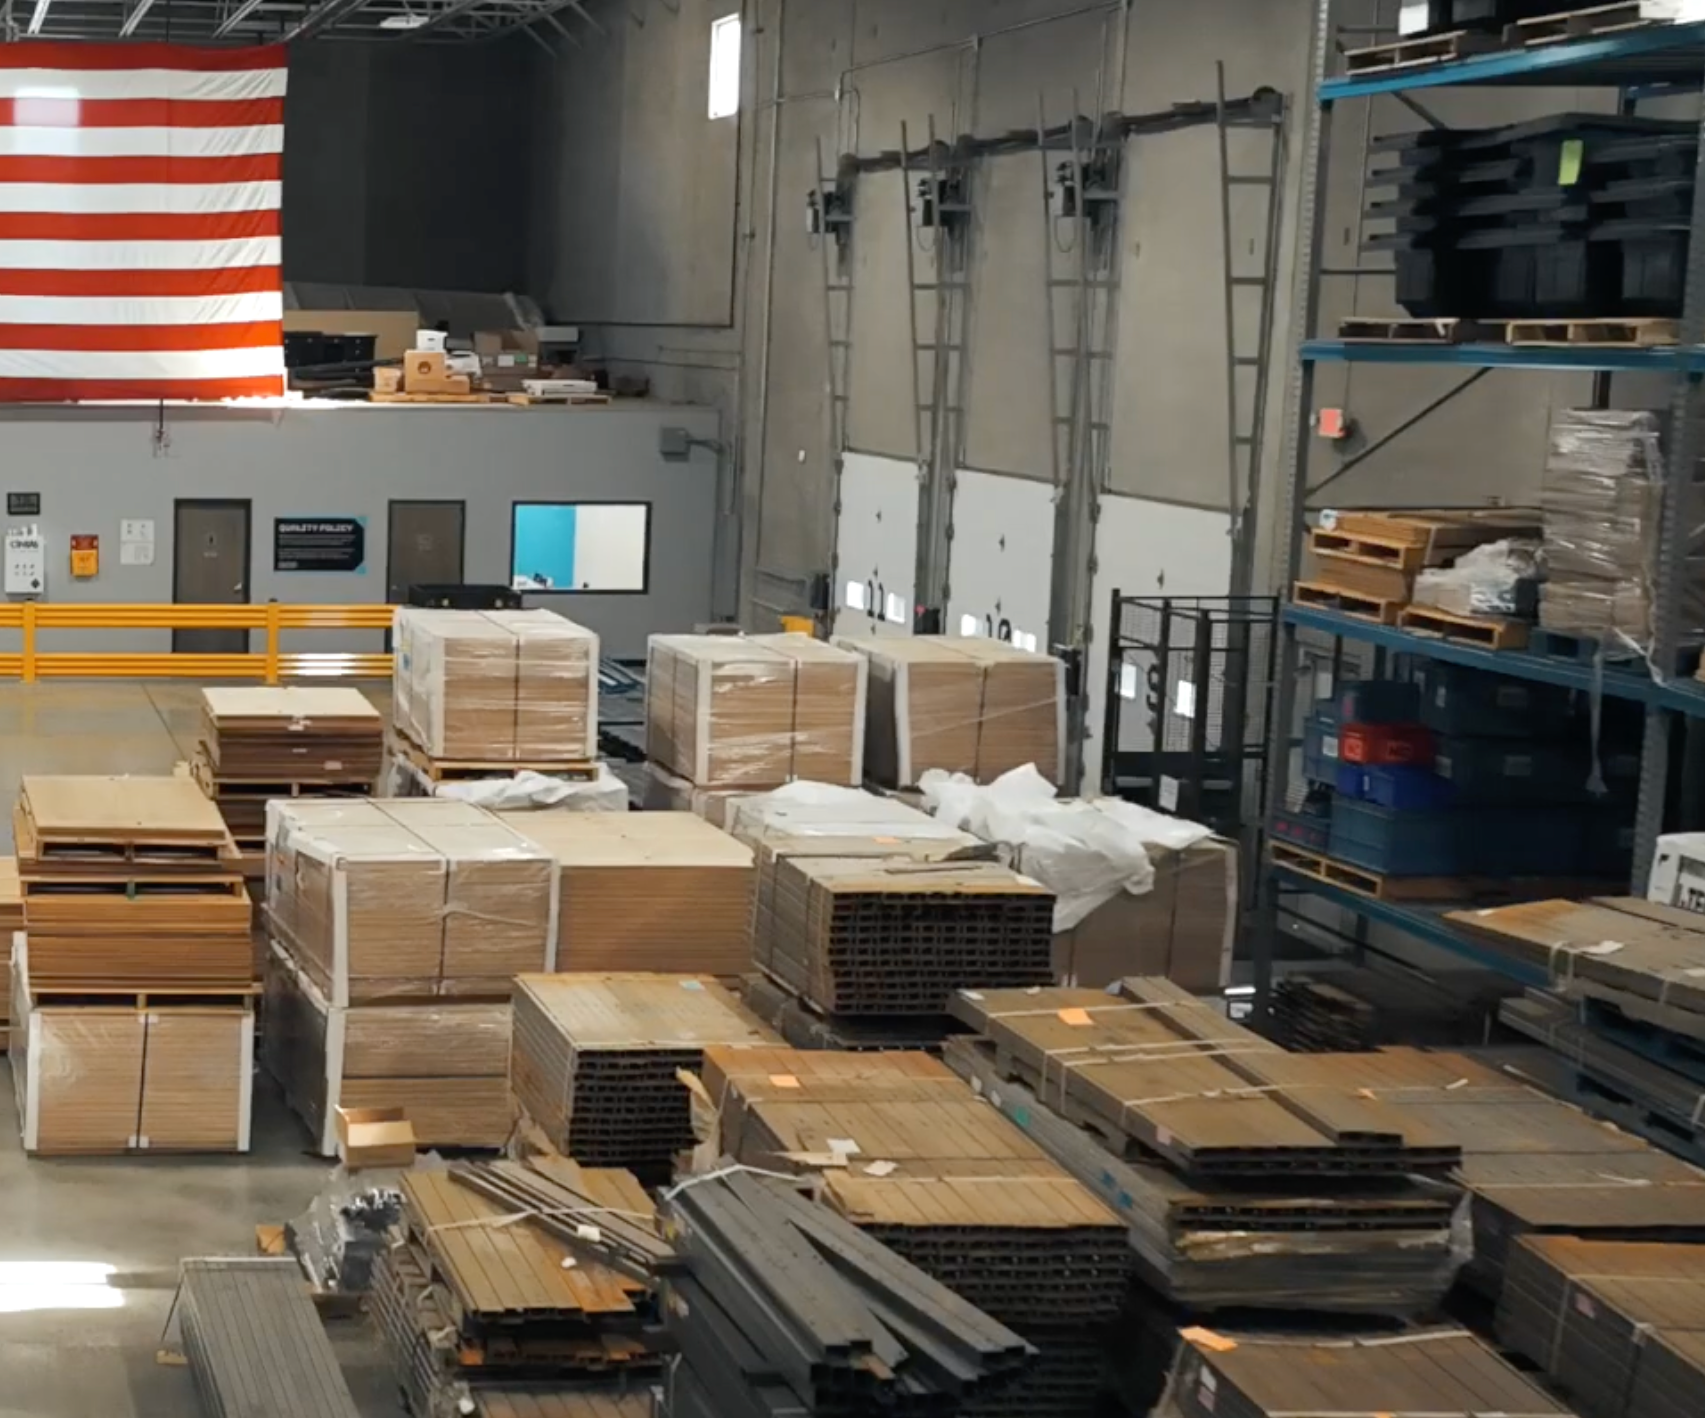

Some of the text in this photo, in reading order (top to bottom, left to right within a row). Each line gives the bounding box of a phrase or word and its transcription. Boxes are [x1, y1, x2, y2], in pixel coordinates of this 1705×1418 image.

[278, 523, 354, 533] QUALITY POLICY
[867, 579, 886, 621] 11
